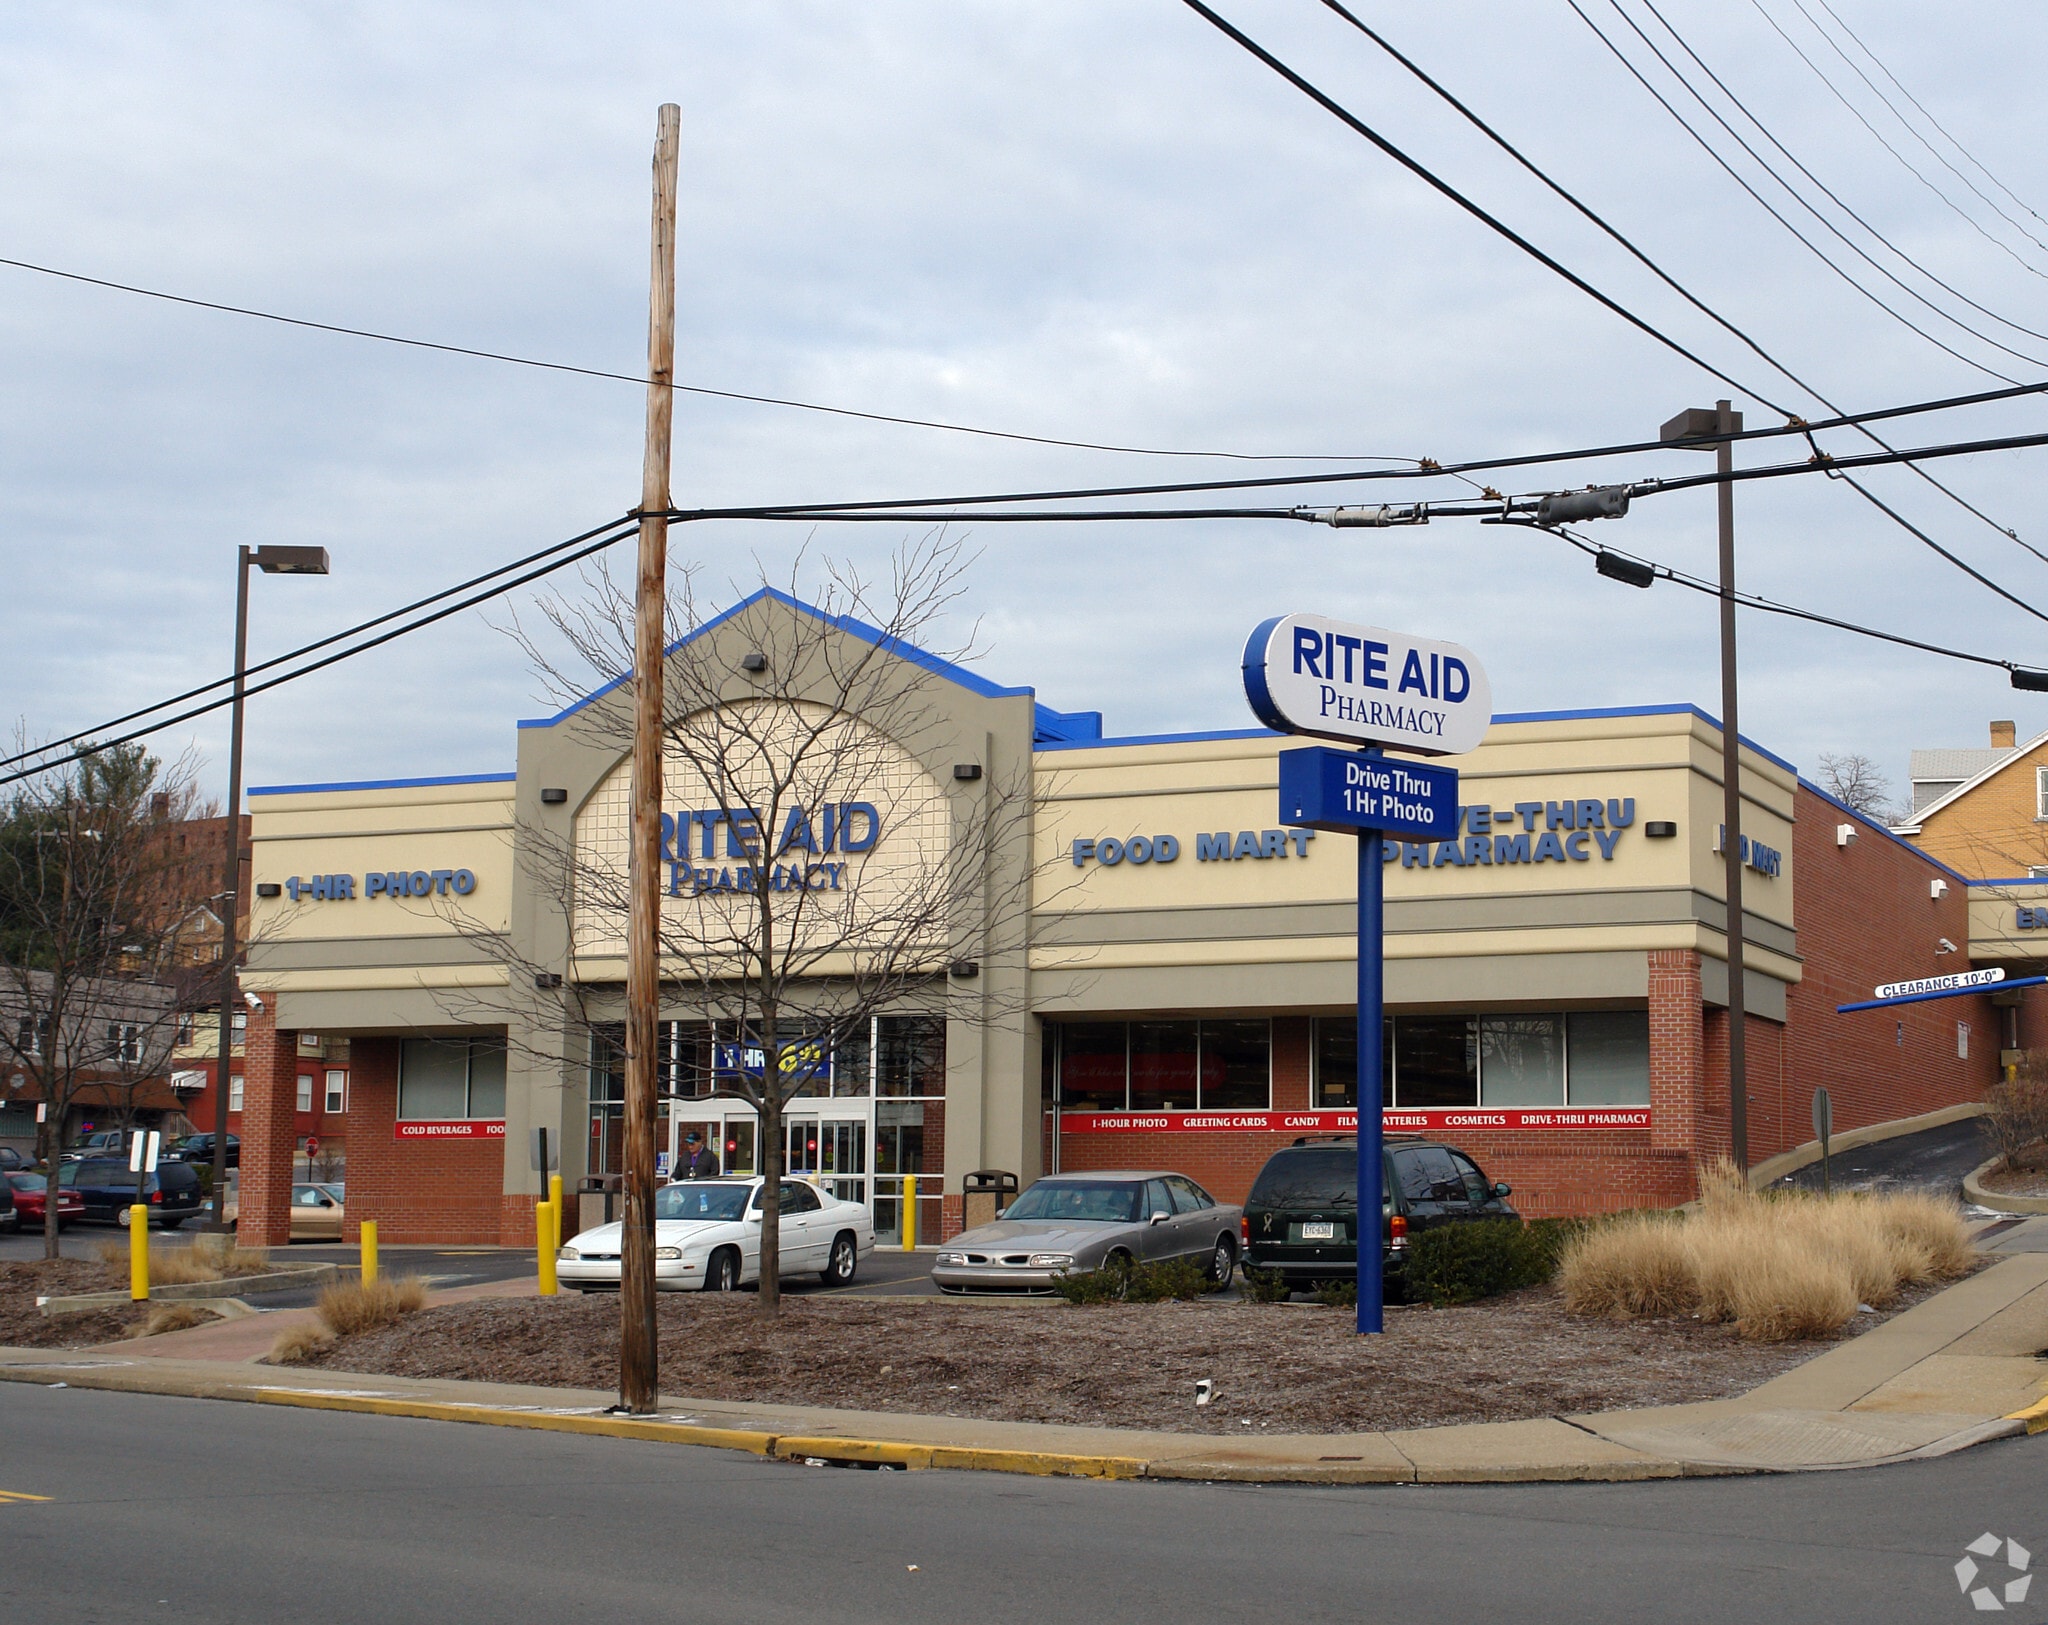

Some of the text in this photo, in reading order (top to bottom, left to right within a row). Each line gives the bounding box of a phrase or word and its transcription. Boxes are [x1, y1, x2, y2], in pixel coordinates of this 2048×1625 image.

[1293, 626, 1470, 703] RITE AID
[1346, 762, 1431, 797] Drive Thru
[1344, 789, 1434, 823] 1 Hr Photo
[778, 802, 880, 855] AID
[1072, 828, 1315, 867] FOOD MART
[285, 868, 477, 901] 1-HR PHOTO
[1883, 976, 1959, 997] CLEARANCE
[1132, 1118, 1168, 1128] PHOTO
[1183, 1117, 1268, 1127] GREETING CARDS
[1284, 1116, 1320, 1126] CANDY
[1382, 1116, 1428, 1126] ATTERIES
[1445, 1115, 1506, 1125] COSMETICS
[1521, 1114, 1648, 1125] DRIVE-THRU PHARMACY
[402, 1125, 472, 1135] COLD BEVERAGES
